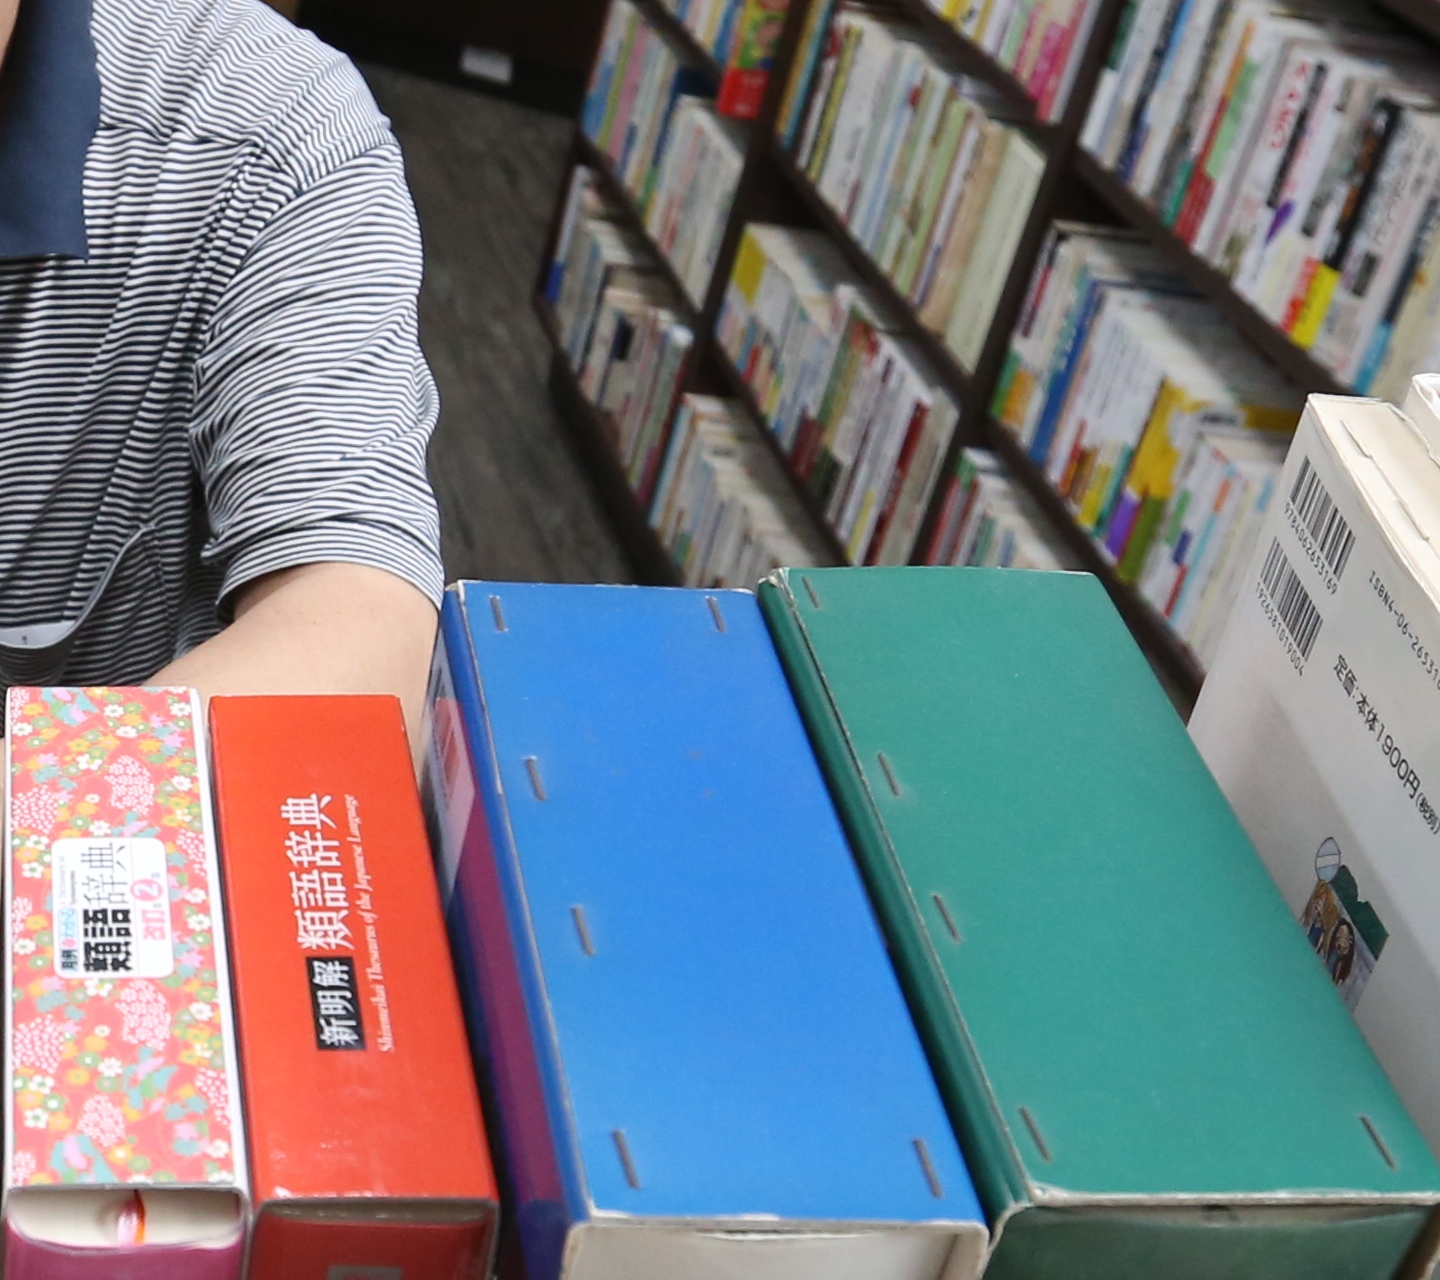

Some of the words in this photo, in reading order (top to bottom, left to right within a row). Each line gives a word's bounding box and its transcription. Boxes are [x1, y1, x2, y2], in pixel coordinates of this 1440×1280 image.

[343, 792, 363, 843] Language
[280, 792, 356, 952] 類語辞典
[350, 843, 374, 892] Japanese
[354, 892, 373, 910] the
[80, 841, 134, 972] 類語辞典
[311, 959, 360, 1048] 新明解
